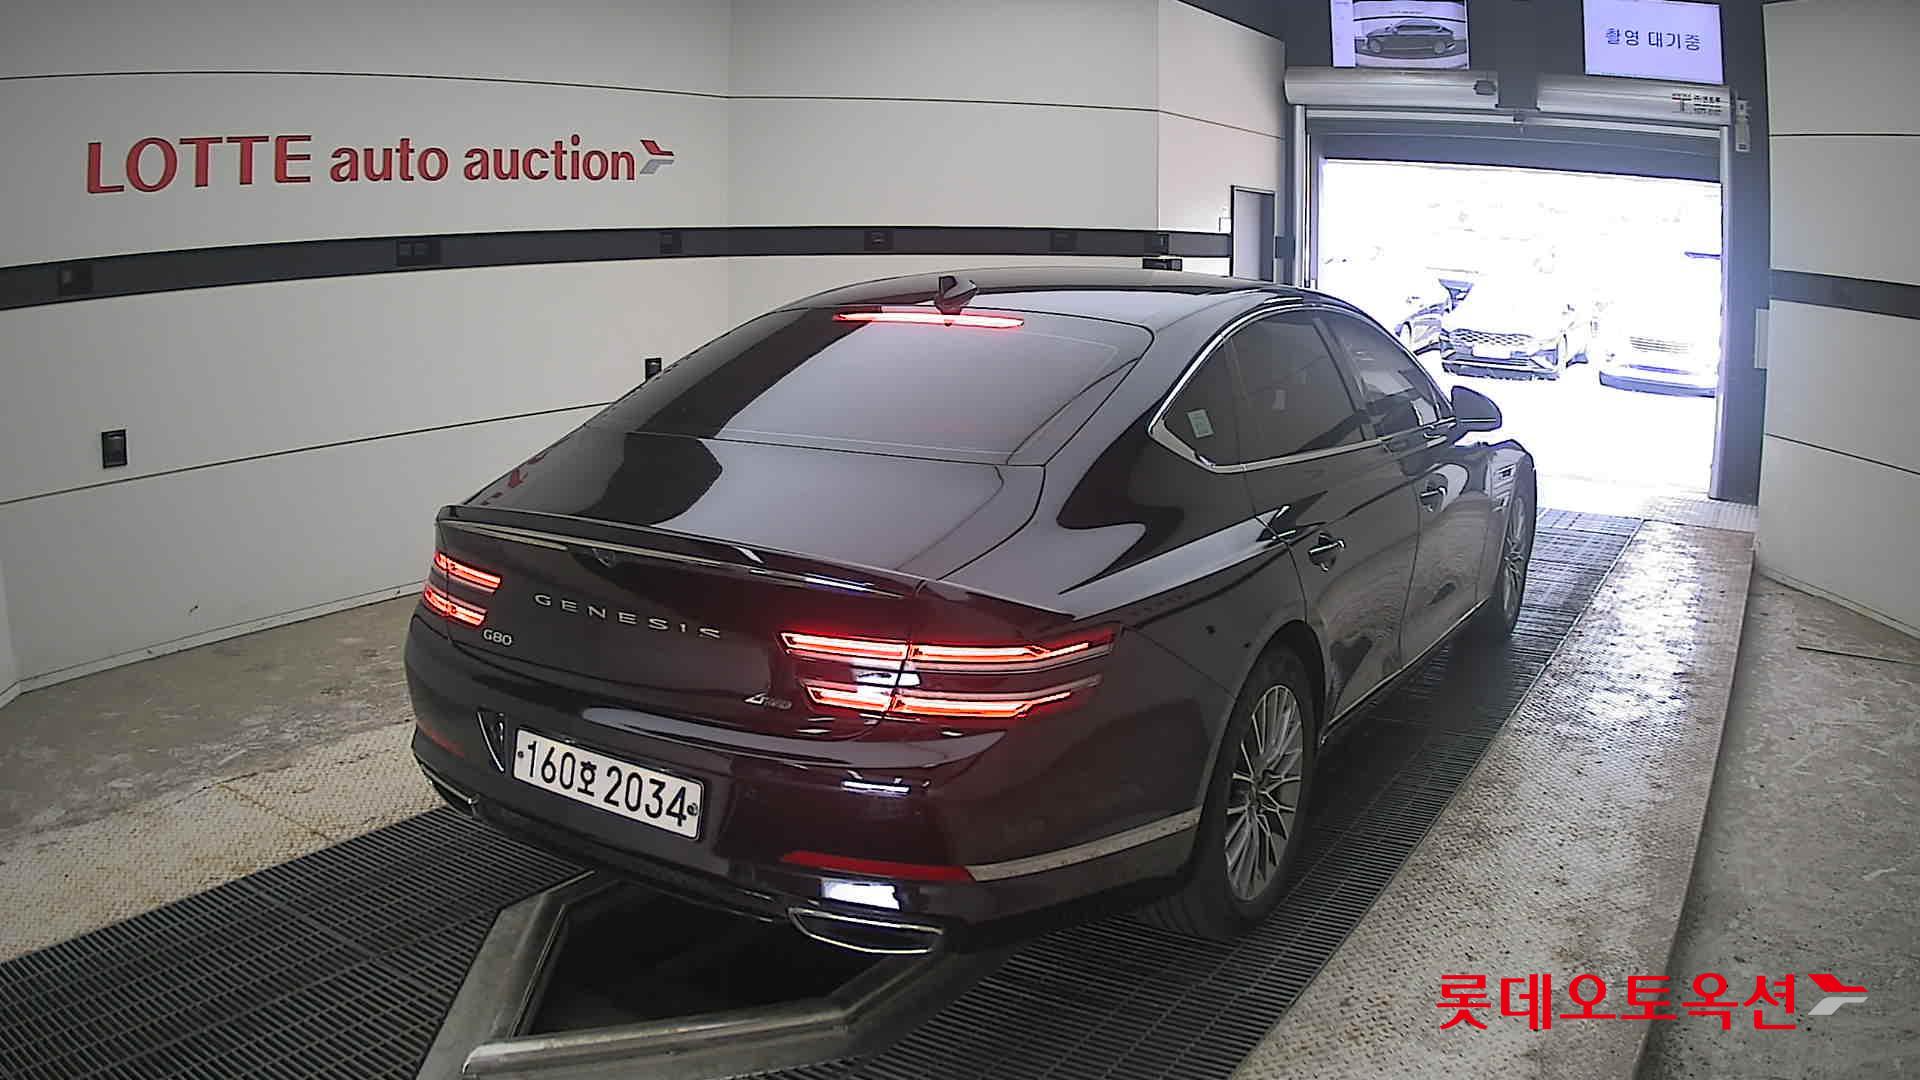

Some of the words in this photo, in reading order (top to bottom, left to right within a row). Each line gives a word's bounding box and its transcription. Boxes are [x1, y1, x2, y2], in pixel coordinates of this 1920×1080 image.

[1606, 27, 1640, 46] 촬영
[1648, 31, 1700, 51] 대기중
[86, 135, 312, 194] LOTTE
[329, 139, 450, 184] auto
[463, 134, 637, 182] auction
[482, 628, 513, 647] G80
[534, 593, 721, 639] GENESIS
[527, 740, 598, 798] 160호
[603, 765, 688, 828] 2034
